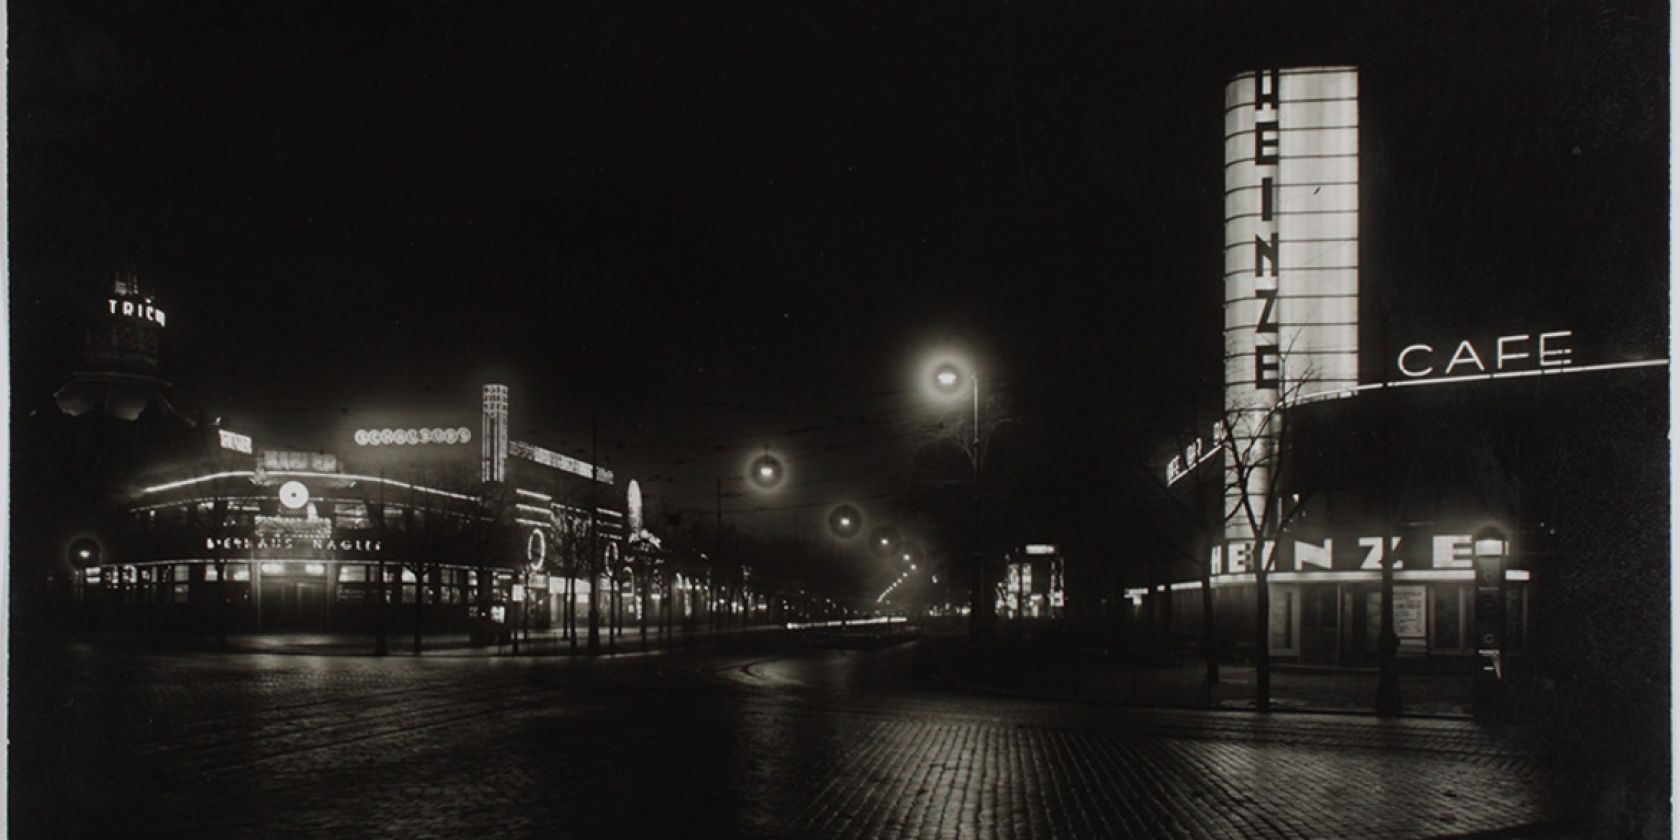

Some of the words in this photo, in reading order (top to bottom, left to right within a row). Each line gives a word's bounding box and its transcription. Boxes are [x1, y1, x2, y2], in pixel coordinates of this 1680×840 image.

[1254, 68, 1279, 390] HEINZE
[1397, 330, 1573, 377] CAFE
[1210, 534, 1474, 576] HEINZE
